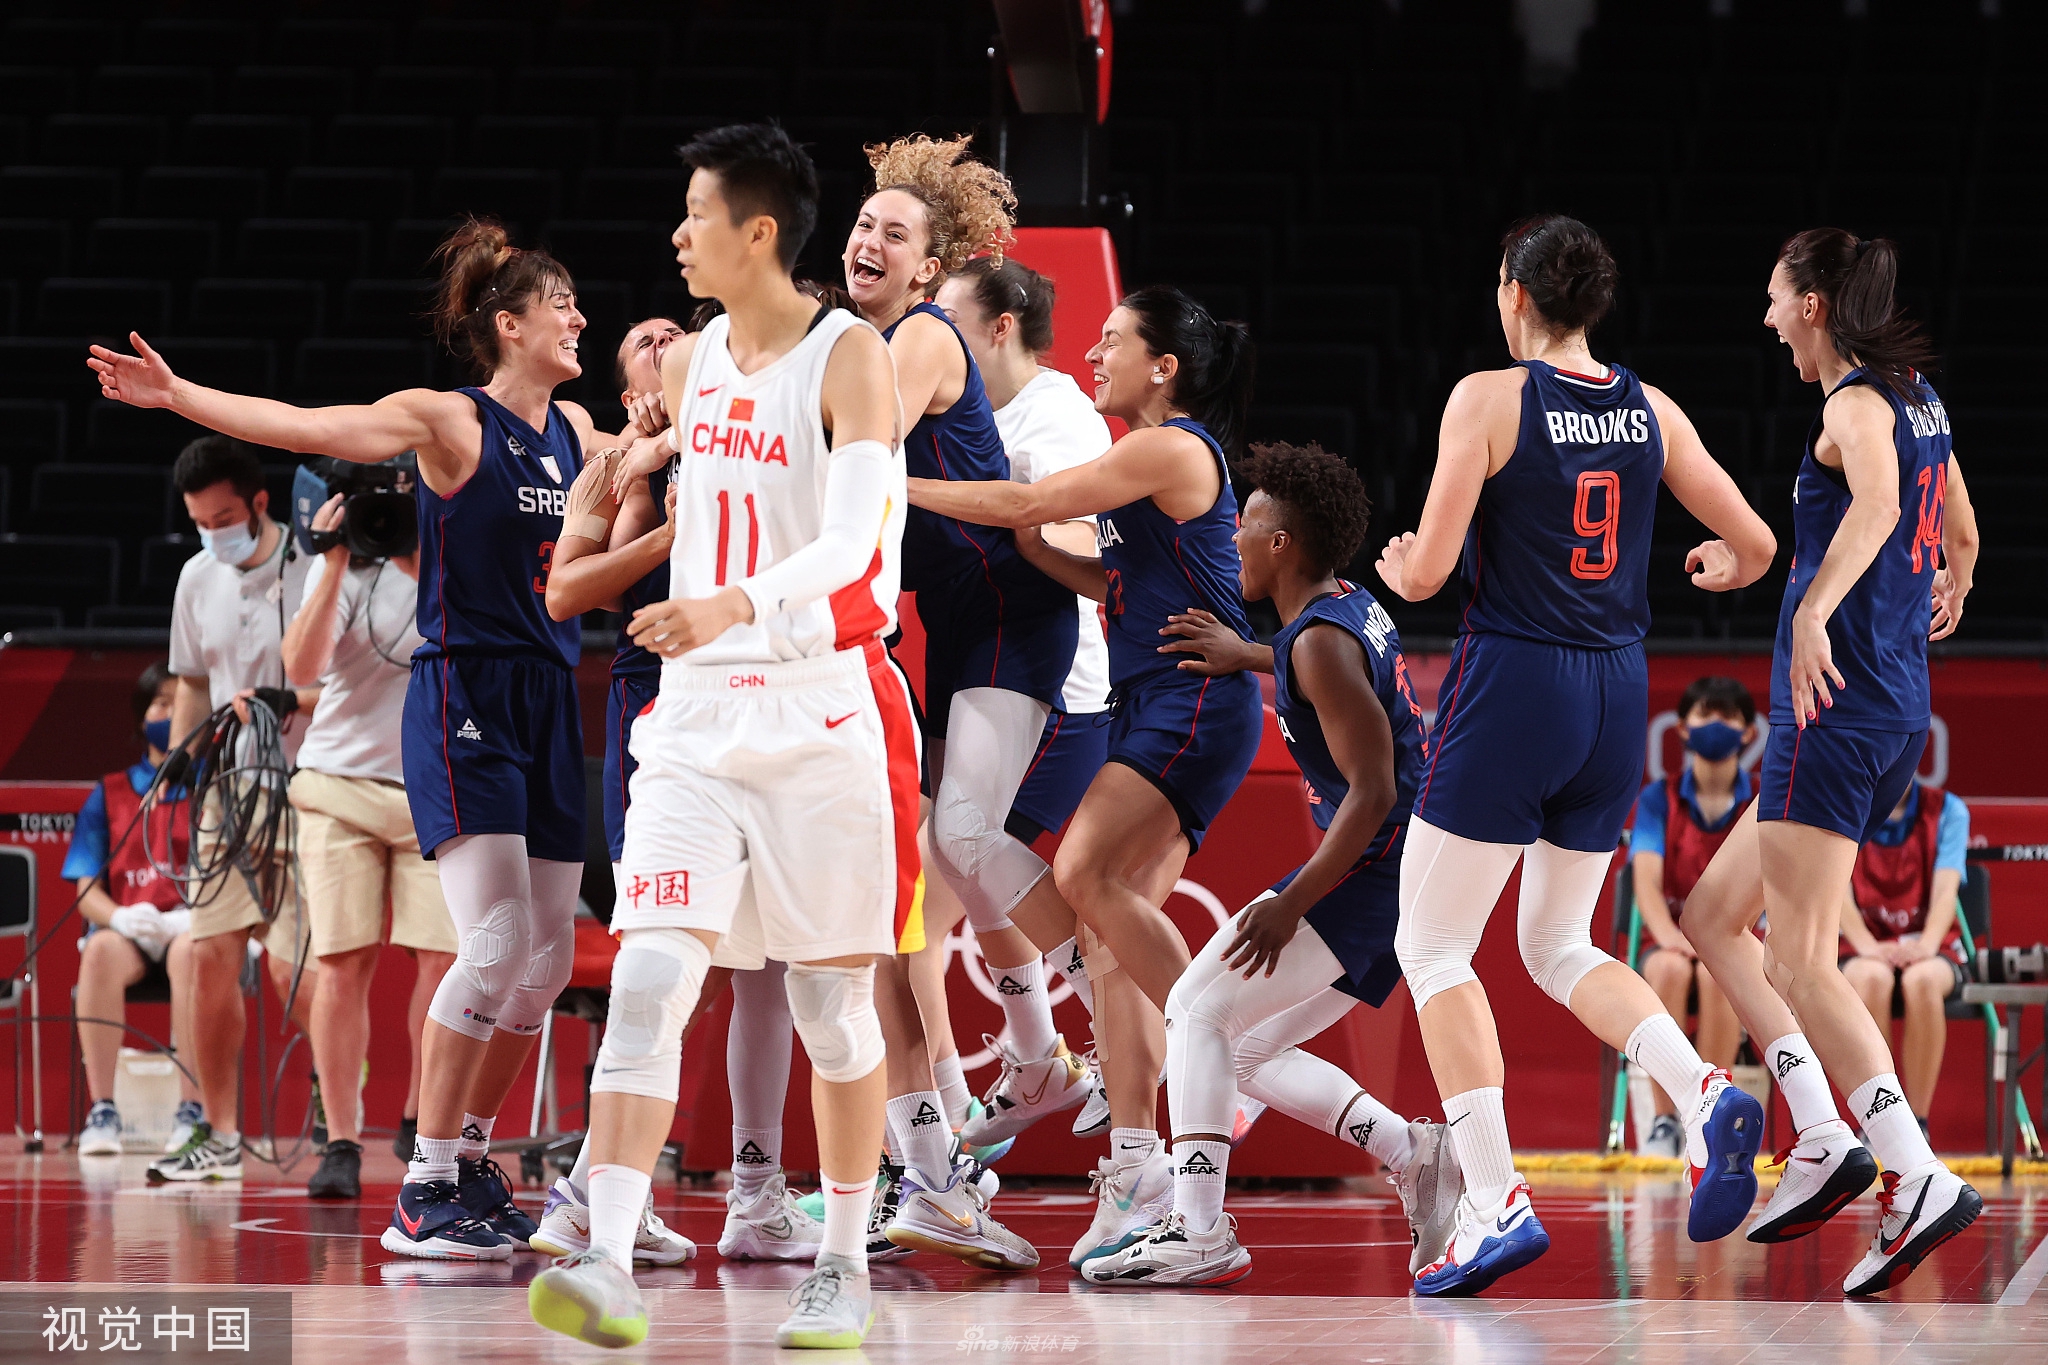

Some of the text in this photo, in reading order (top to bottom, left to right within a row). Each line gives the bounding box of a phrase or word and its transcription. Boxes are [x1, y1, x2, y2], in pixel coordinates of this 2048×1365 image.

[1546, 409, 1649, 444] BROOKS
[692, 423, 788, 467] CHINA
[518, 486, 569, 516] SRB
[1570, 471, 1620, 580] 9
[1911, 463, 1947, 573] 14
[715, 490, 758, 586] 11
[730, 675, 765, 687] CHN
[456, 730, 482, 740] PEAK
[19, 813, 75, 832] TOKYO
[626, 870, 689, 909] 中国
[1865, 1095, 1903, 1120] PEAK
[736, 1154, 773, 1164] PEAK
[1179, 1166, 1220, 1175] PEAK
